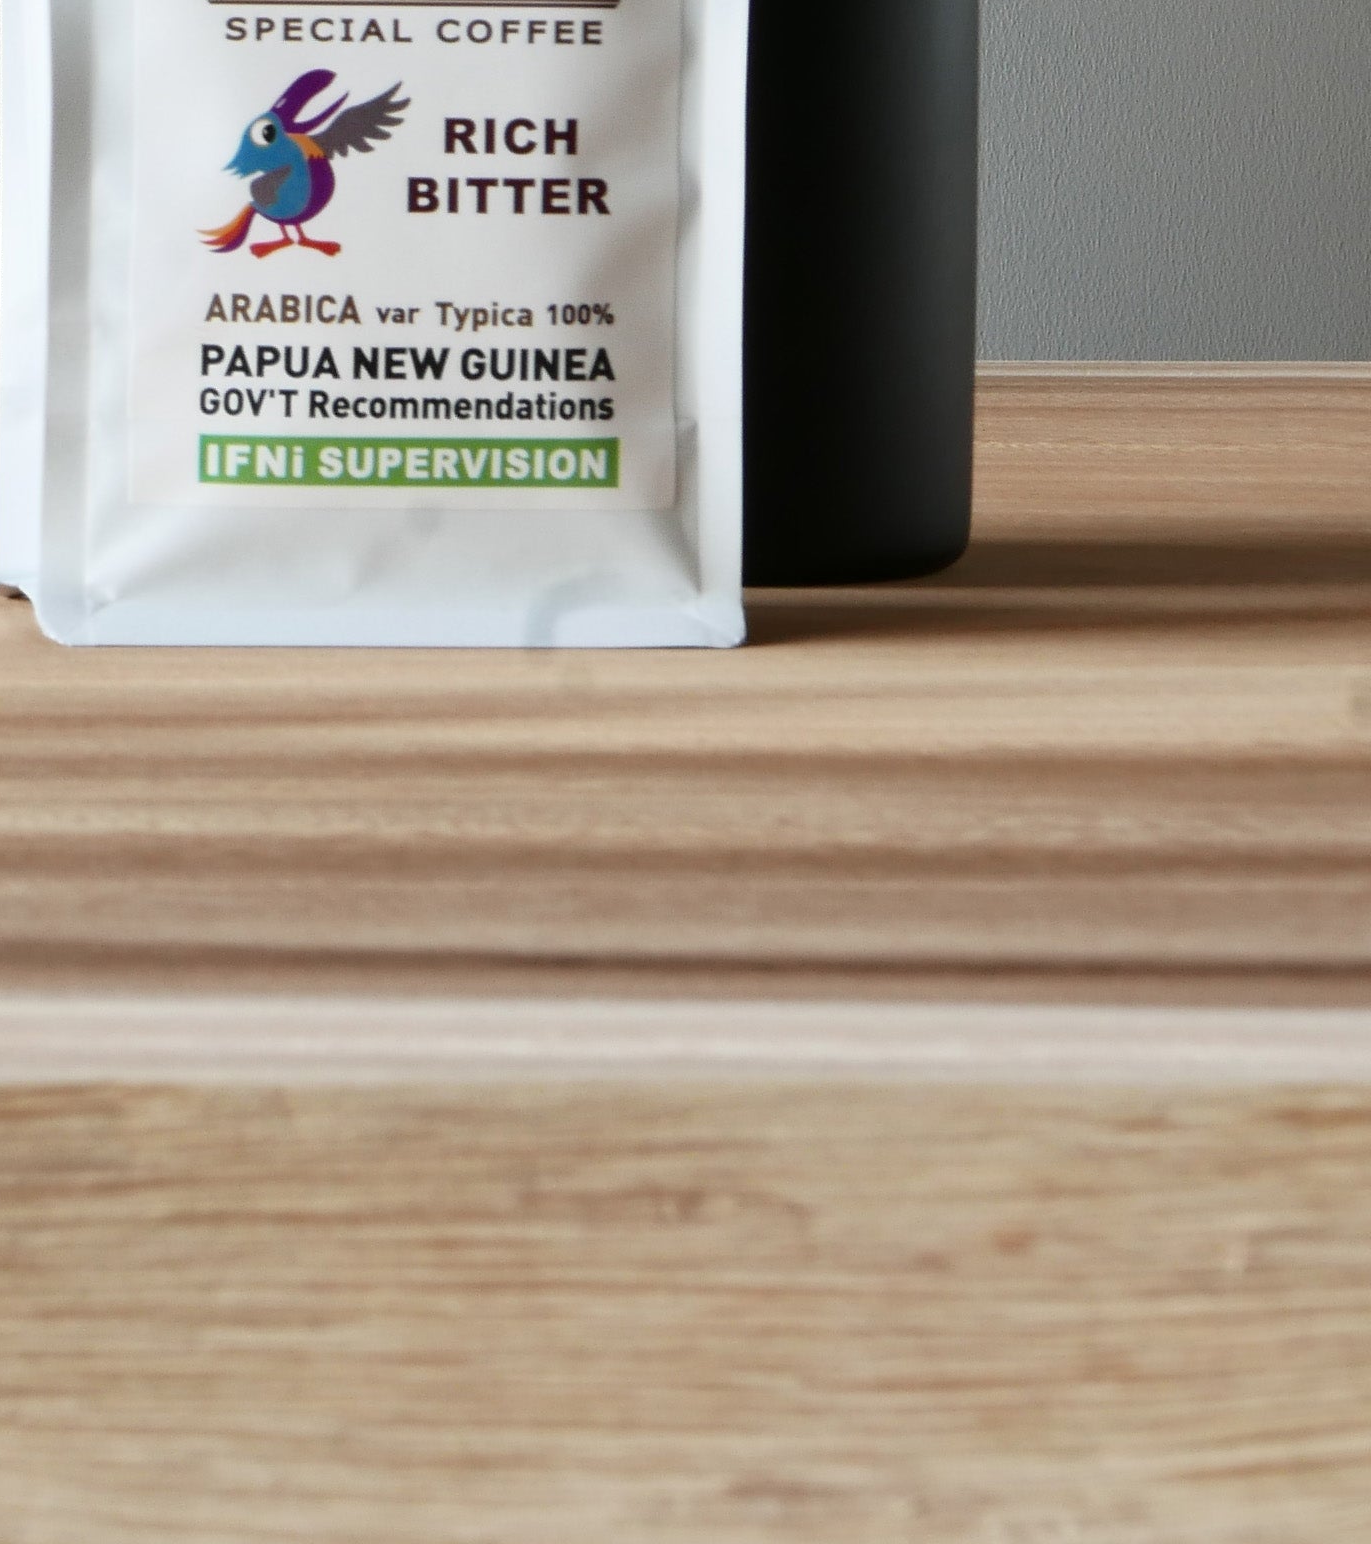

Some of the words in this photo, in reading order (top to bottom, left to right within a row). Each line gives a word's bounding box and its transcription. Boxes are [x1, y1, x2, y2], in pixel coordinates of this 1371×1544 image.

[225, 17, 413, 44] SPECIAL
[436, 19, 603, 46] COFFEE
[443, 117, 579, 156] RICH
[407, 176, 611, 215] BITTER
[204, 293, 362, 324] ARABICA
[376, 305, 420, 325] var
[436, 302, 534, 332] Typica
[547, 303, 615, 326] 100%
[200, 343, 341, 380] PAPUA
[352, 346, 450, 381] NEW
[460, 347, 616, 382] GUINEA
[199, 388, 299, 417] GOV'T
[308, 390, 614, 421] Recommendations
[205, 443, 304, 479] IFNi
[317, 446, 607, 481] SUPERVISION
